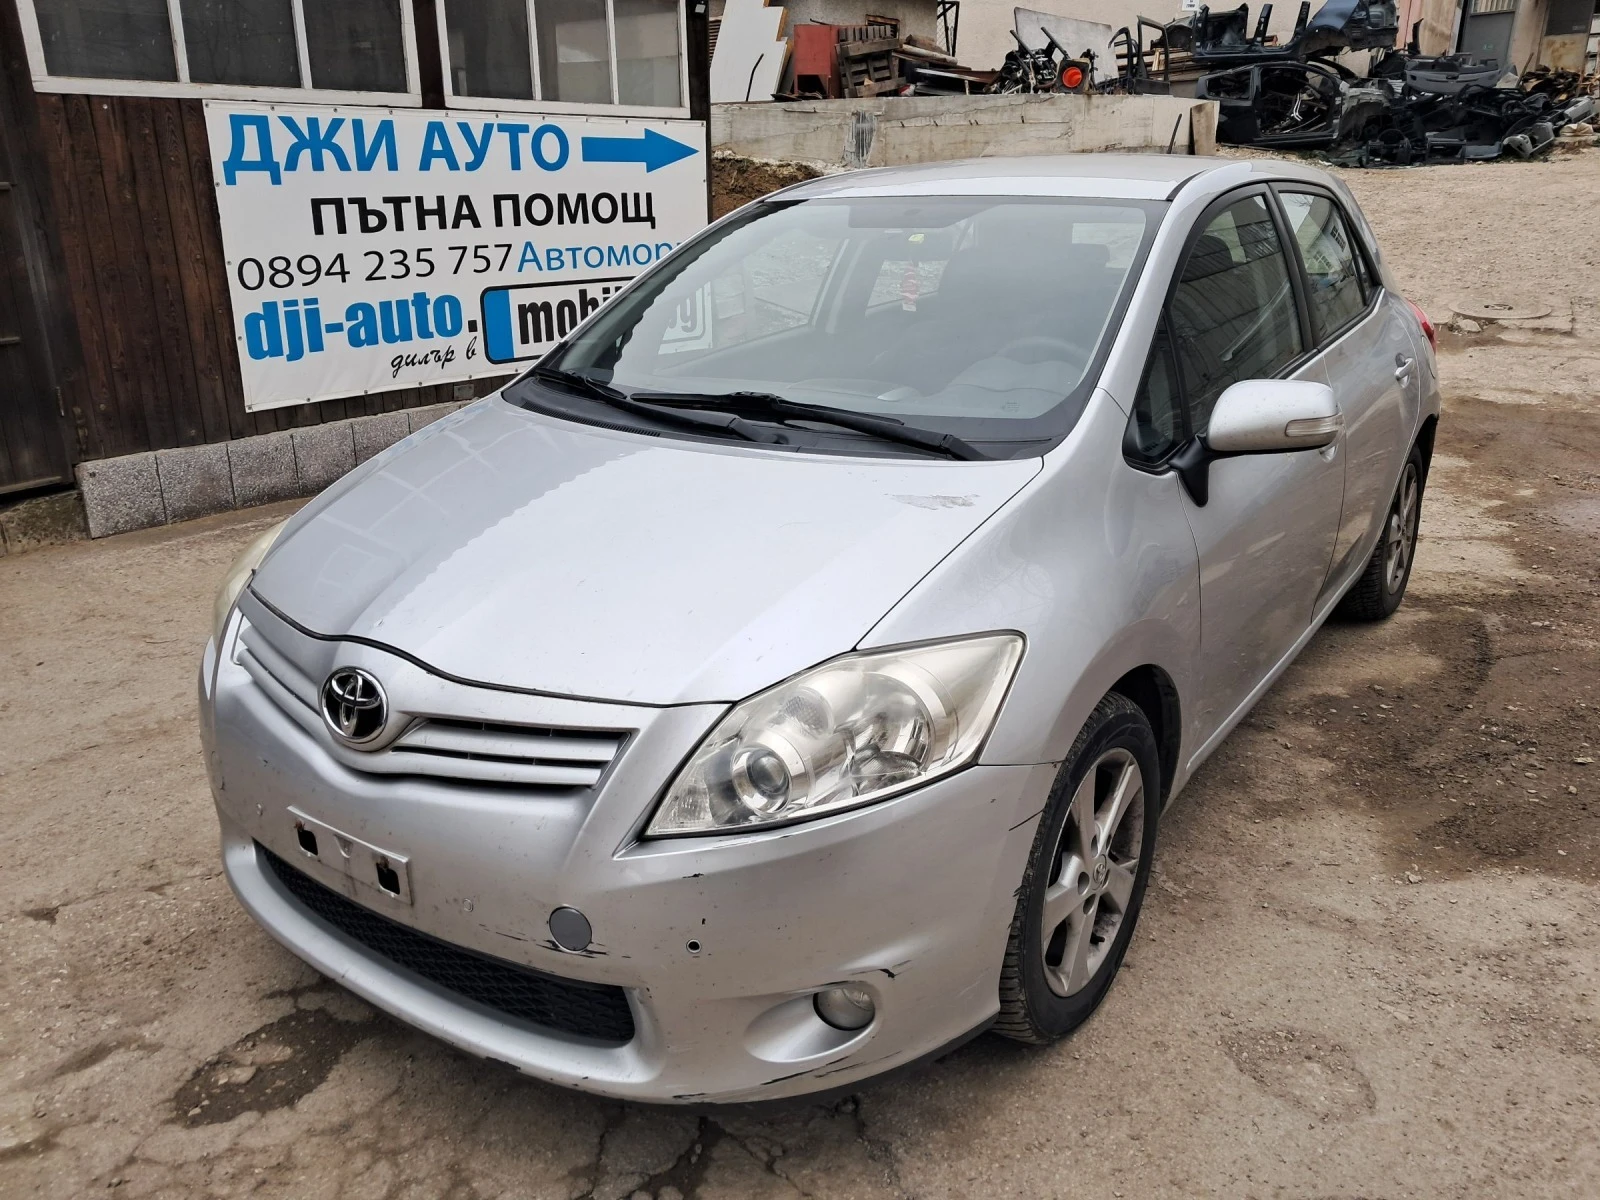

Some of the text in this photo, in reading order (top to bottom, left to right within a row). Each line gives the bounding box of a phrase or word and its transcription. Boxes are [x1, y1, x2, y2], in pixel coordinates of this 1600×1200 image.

[222, 114, 570, 186] ДЖИ АУТО
[311, 192, 656, 235] ПЪТНА ПОМОЩ
[237, 243, 513, 290] 0894 235 757
[517, 241, 682, 272] Автомор
[391, 335, 478, 378] дилър в
